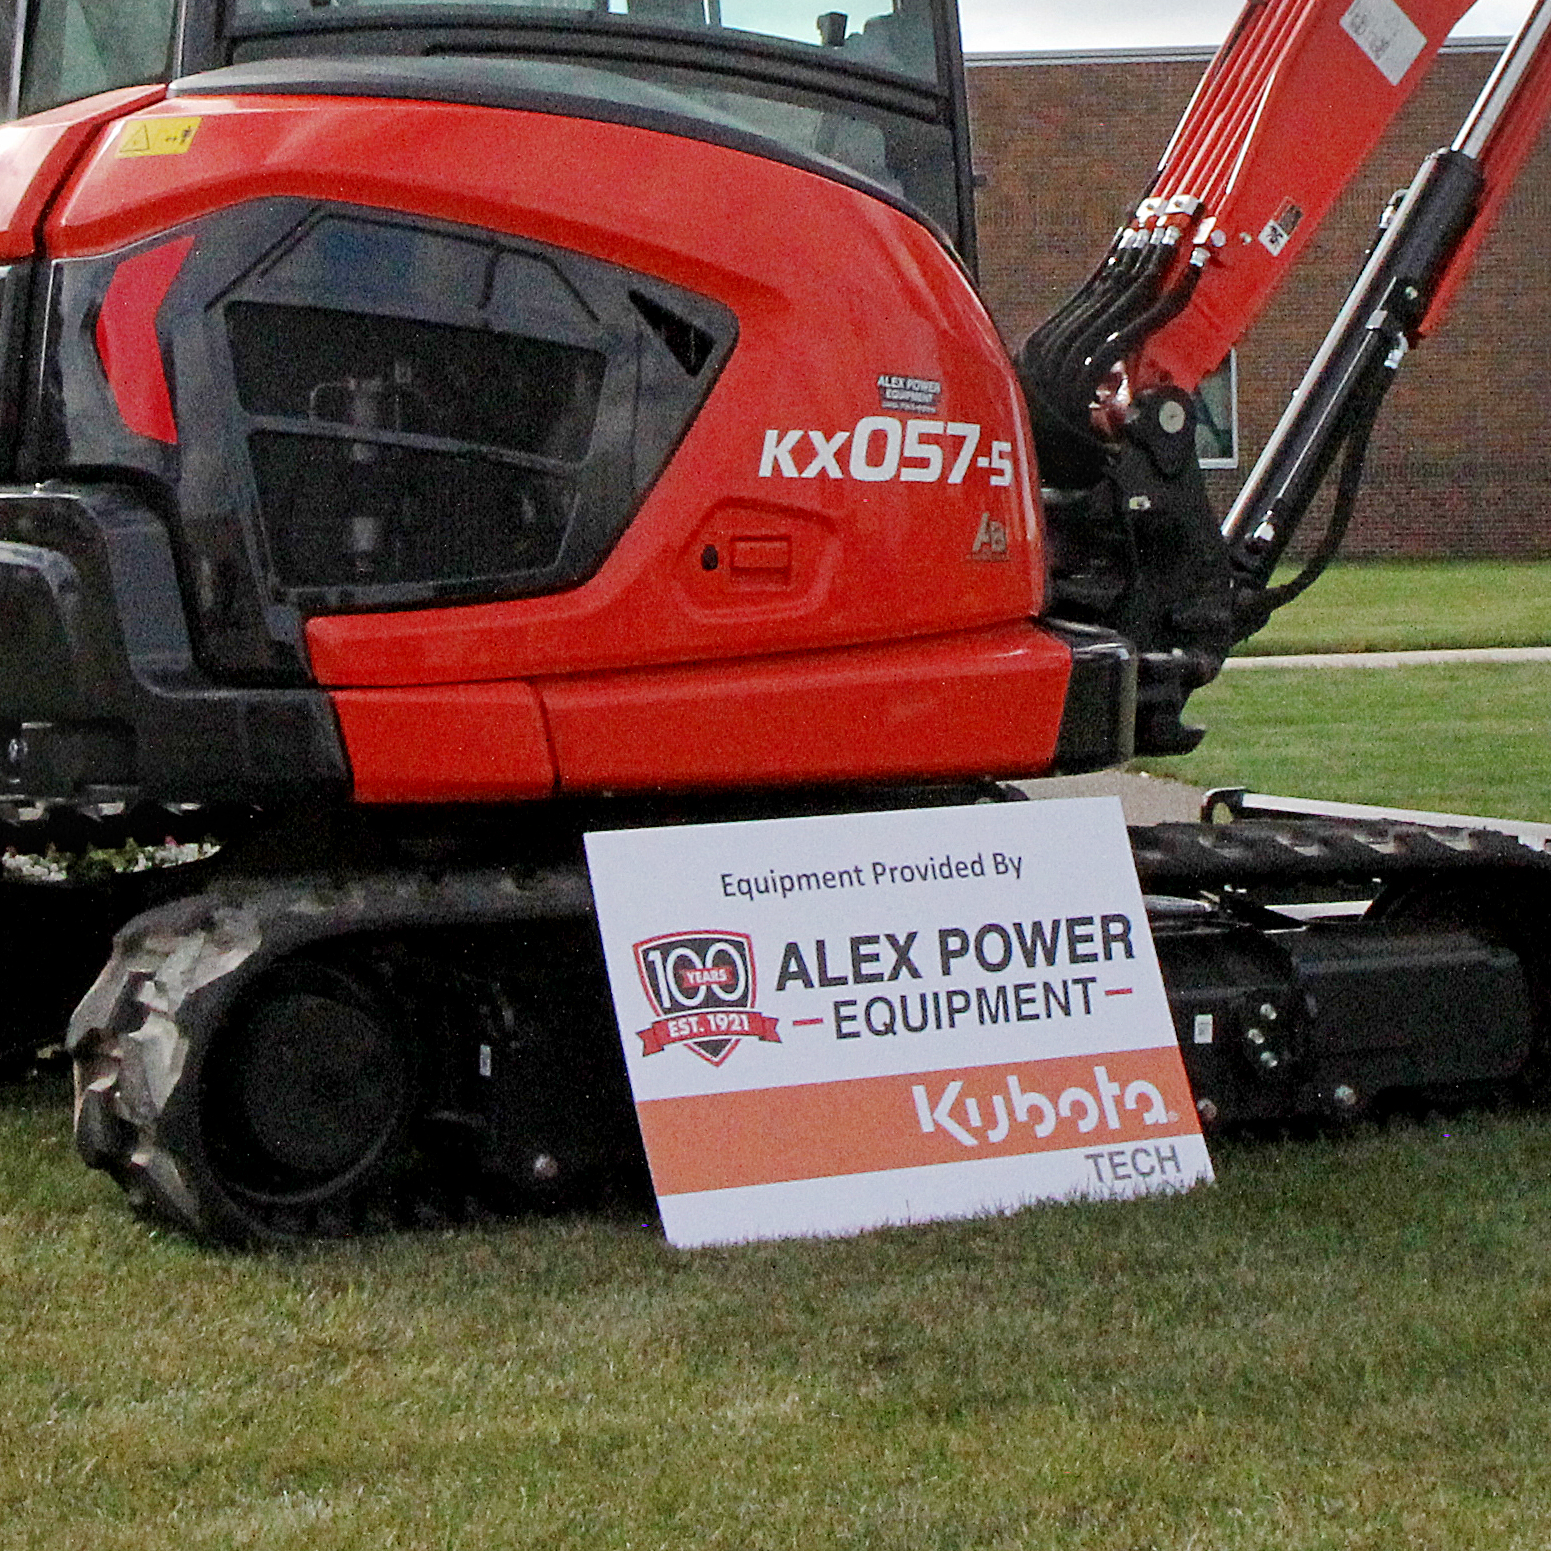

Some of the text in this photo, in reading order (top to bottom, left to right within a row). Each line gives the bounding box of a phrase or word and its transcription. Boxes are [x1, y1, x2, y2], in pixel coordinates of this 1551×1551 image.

[877, 375, 907, 389] ALEX
[758, 416, 1012, 487] KX057-5
[720, 851, 1023, 901] Equipment Provided By
[647, 941, 746, 1009] 100
[686, 969, 728, 984] YEARS
[775, 912, 1136, 992] ALEX POWER
[667, 1013, 749, 1038] EST. 1921
[833, 976, 1098, 1040] EQUIPMENT
[911, 1065, 1169, 1146] Kubota
[1084, 1143, 1182, 1184] TECH
